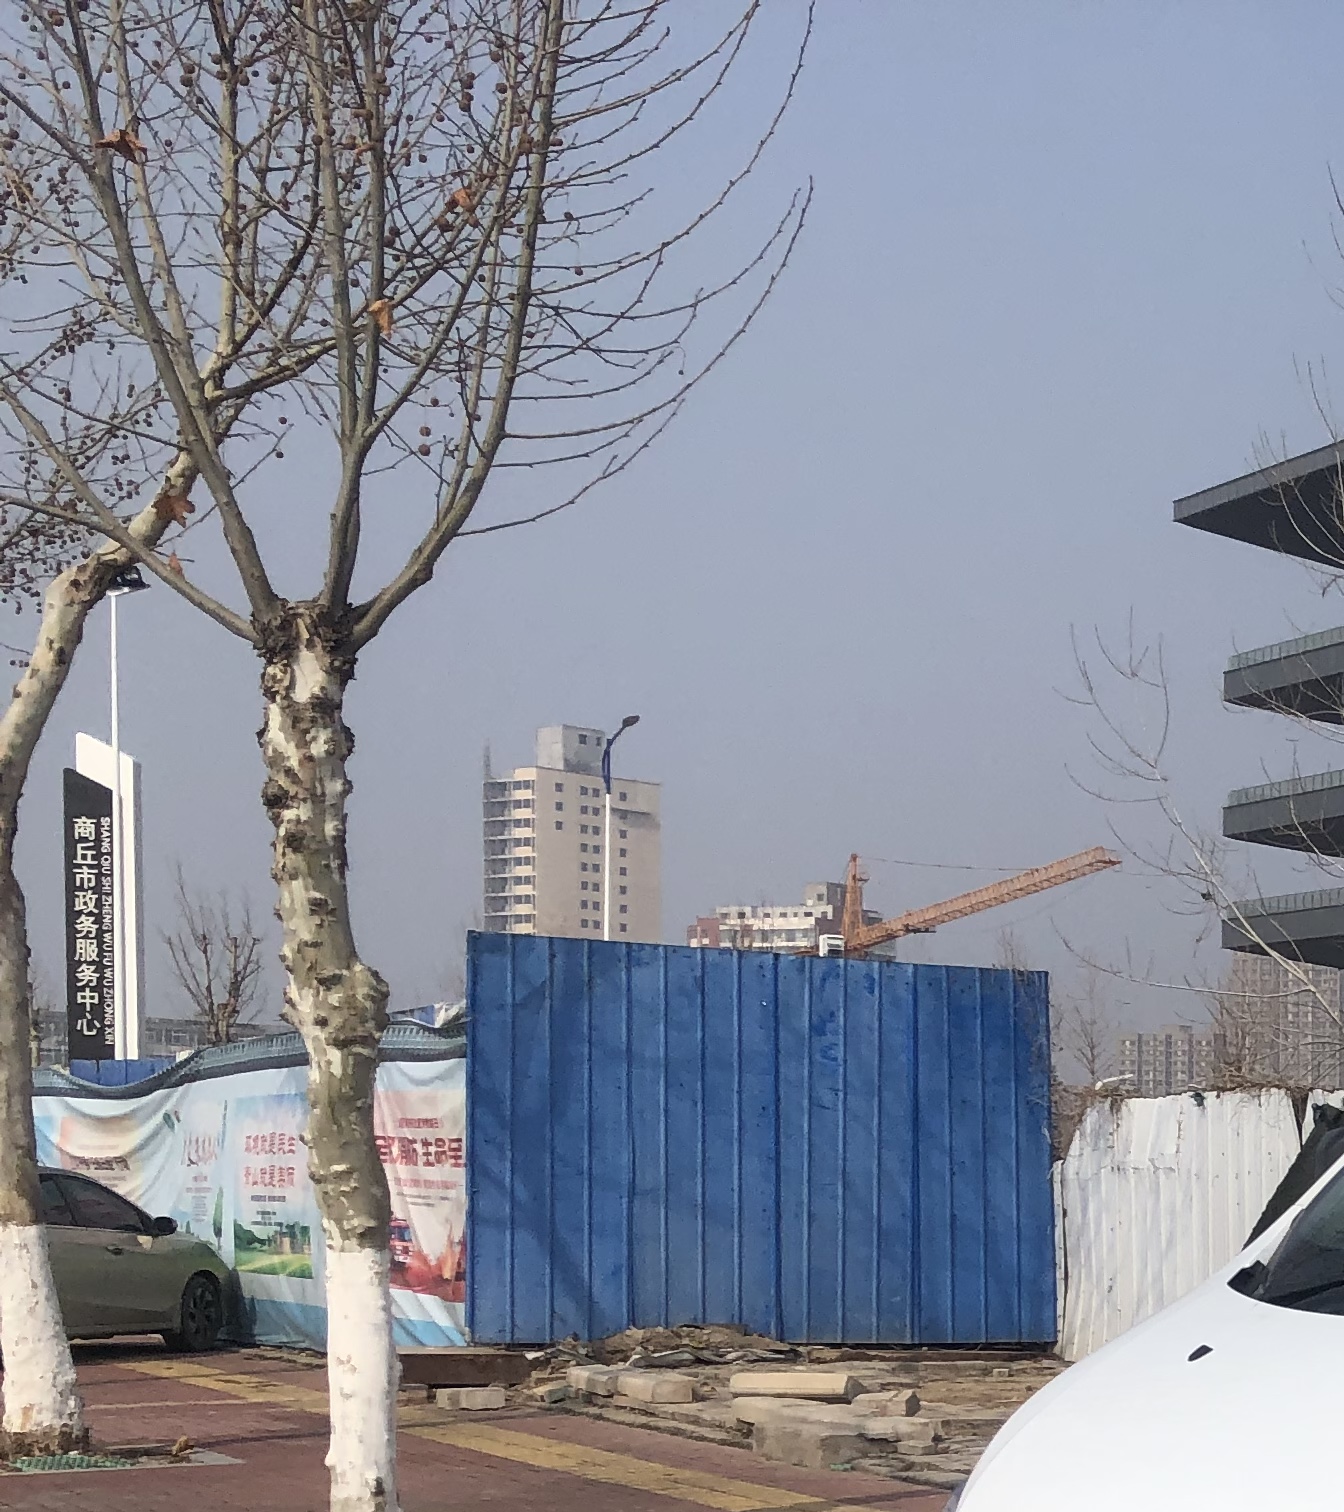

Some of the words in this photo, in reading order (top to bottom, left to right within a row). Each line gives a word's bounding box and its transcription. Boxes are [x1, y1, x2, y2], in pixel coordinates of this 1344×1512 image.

[101, 816, 112, 853] SHANG
[101, 855, 112, 874] QIU
[101, 876, 112, 893] SHI
[101, 894, 113, 930] ZHENG
[72, 815, 102, 1037] 商丘市政务服务中心
[102, 932, 113, 951] WU
[103, 952, 113, 965] FU
[103, 967, 114, 986] WU
[103, 987, 115, 1025] ZHONG
[104, 1026, 115, 1045] XIN
